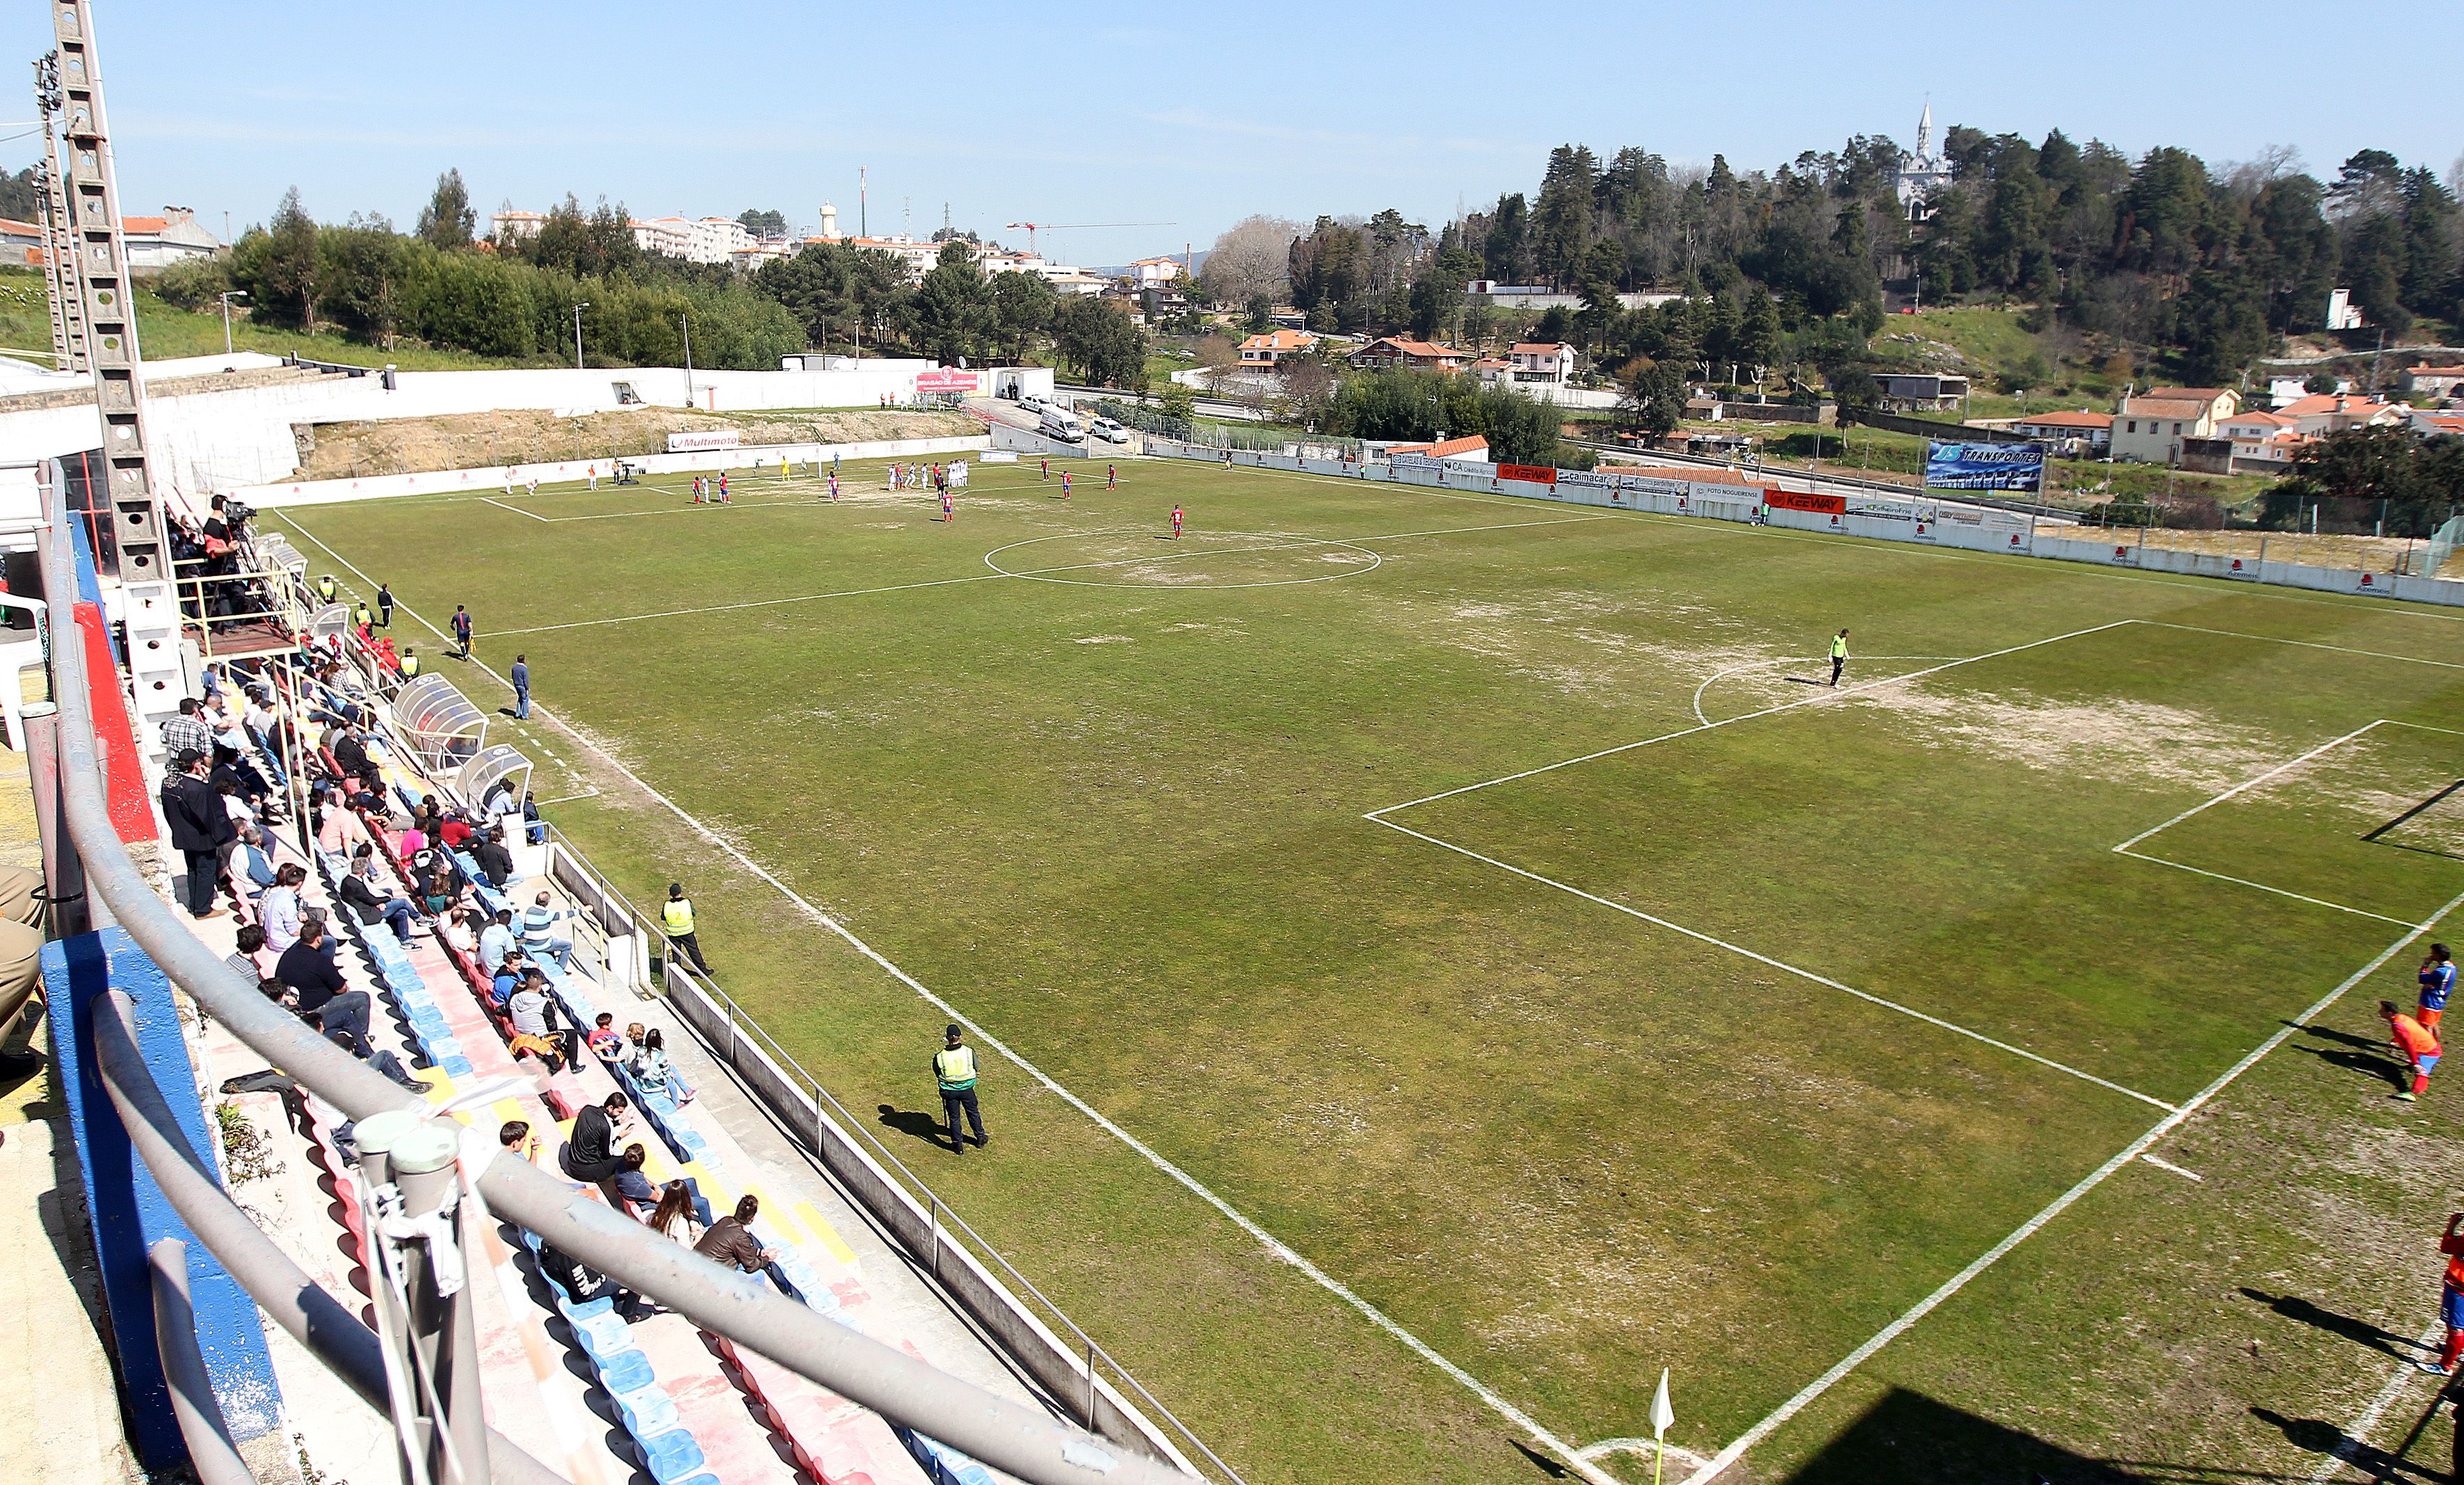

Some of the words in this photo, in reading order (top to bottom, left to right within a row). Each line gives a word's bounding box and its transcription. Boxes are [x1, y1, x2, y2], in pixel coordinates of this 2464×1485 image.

[684, 437, 737, 447] Multimoto
[1963, 451, 2041, 464] TRANSPORTES
[1452, 462, 1463, 471] CA
[1569, 472, 1608, 483] caimacar
[1722, 490, 1758, 498] NOGUEIRENSE
